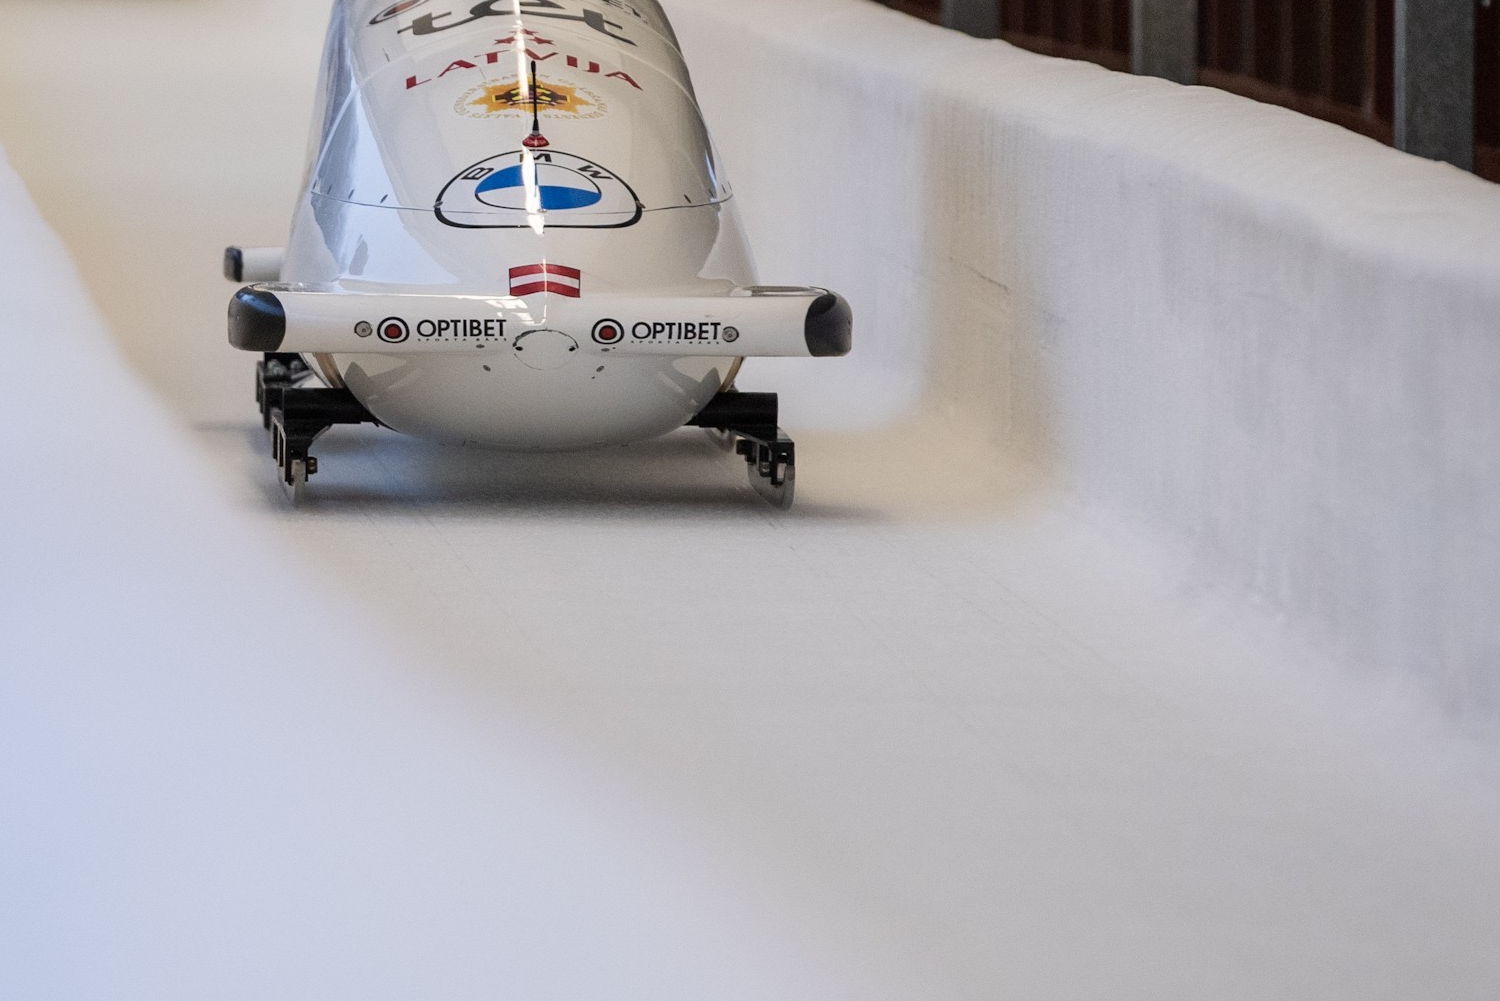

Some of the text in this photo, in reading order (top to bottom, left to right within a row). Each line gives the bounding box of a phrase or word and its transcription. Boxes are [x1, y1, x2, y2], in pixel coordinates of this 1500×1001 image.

[405, 48, 643, 91] LATVIJA
[461, 153, 613, 181] BMW
[416, 319, 507, 337] OPTIBET
[631, 322, 721, 340] OPTIBET
